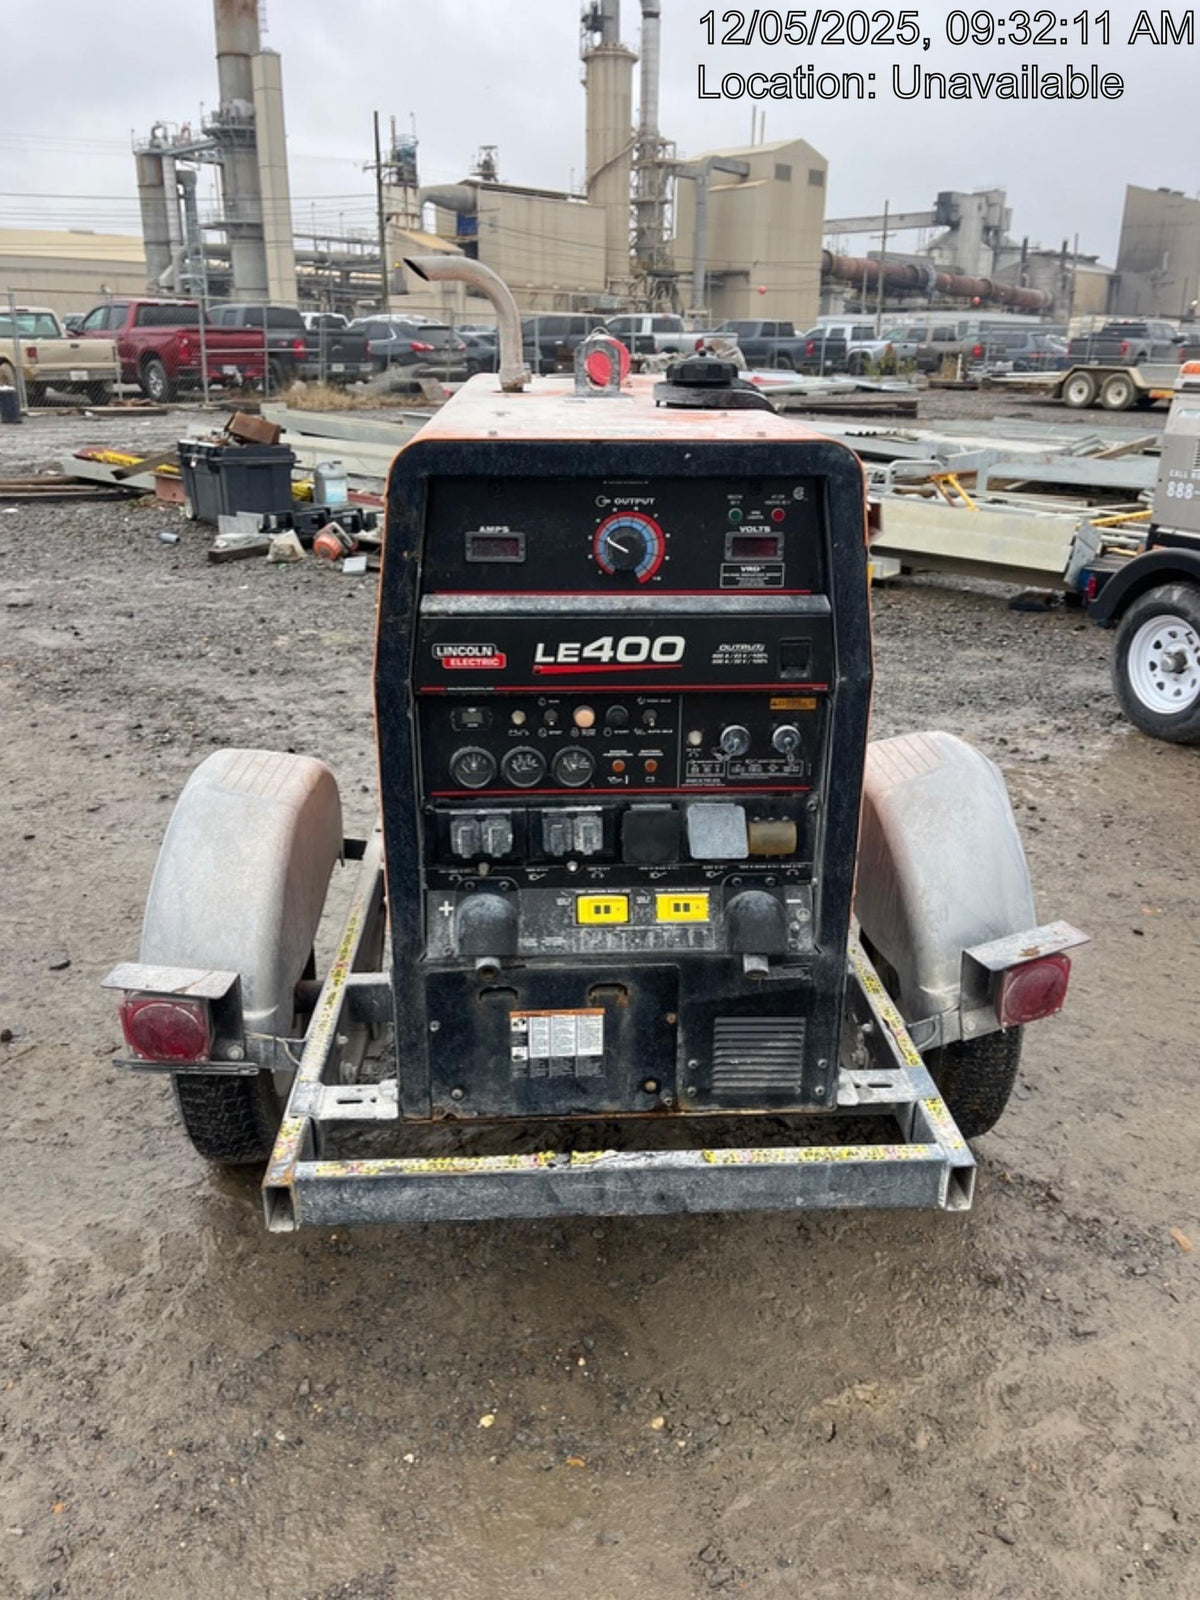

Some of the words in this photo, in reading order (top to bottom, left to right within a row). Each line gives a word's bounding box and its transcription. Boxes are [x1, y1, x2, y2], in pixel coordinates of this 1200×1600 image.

[613, 497, 655, 505] OUTPUT
[478, 525, 510, 533] AMPS
[739, 525, 771, 533] VOLTS
[435, 646, 493, 657] LINCOLN
[534, 635, 686, 663] LE400
[449, 658, 501, 666] ELECTRIC
